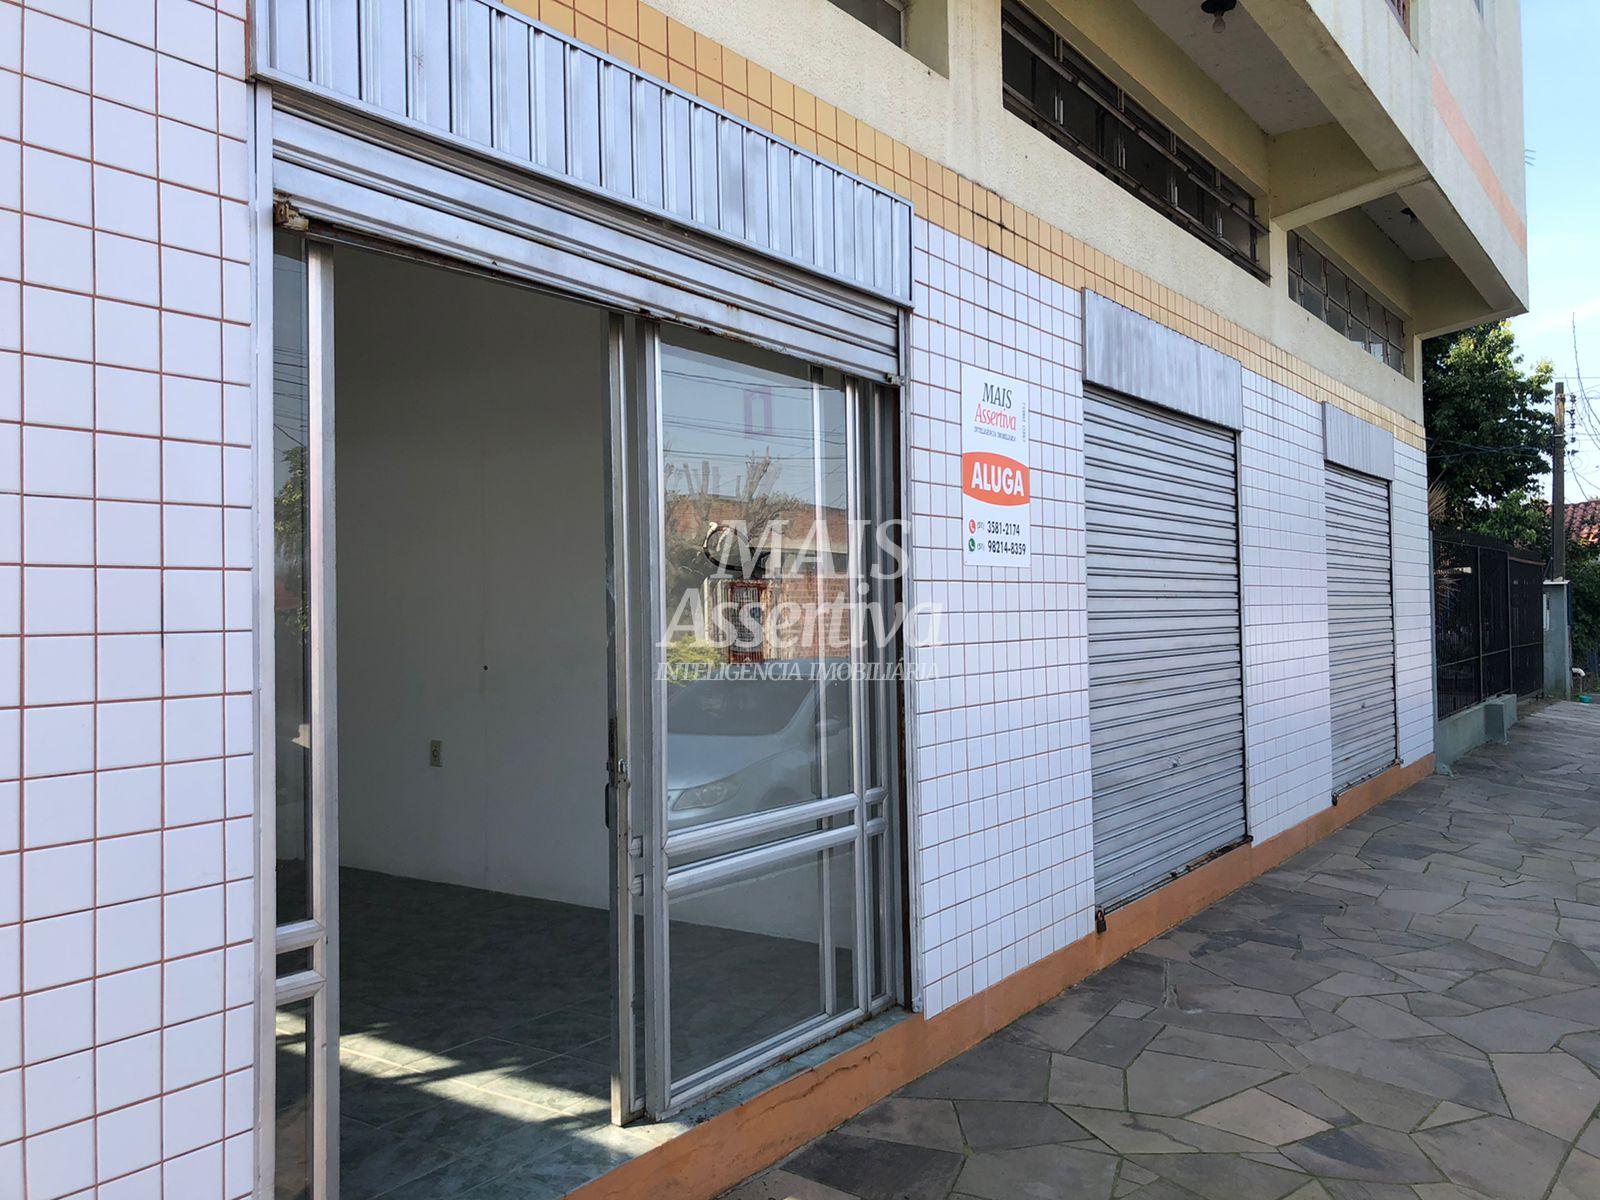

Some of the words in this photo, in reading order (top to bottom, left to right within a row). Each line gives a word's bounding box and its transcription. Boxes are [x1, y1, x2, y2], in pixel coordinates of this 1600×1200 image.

[982, 382, 1013, 410] MAIS
[974, 402, 1017, 432] Assertiva
[971, 461, 1024, 497] ALUGA
[987, 520, 1020, 536] 3581-2174
[987, 539, 1027, 556] 98214-8359
